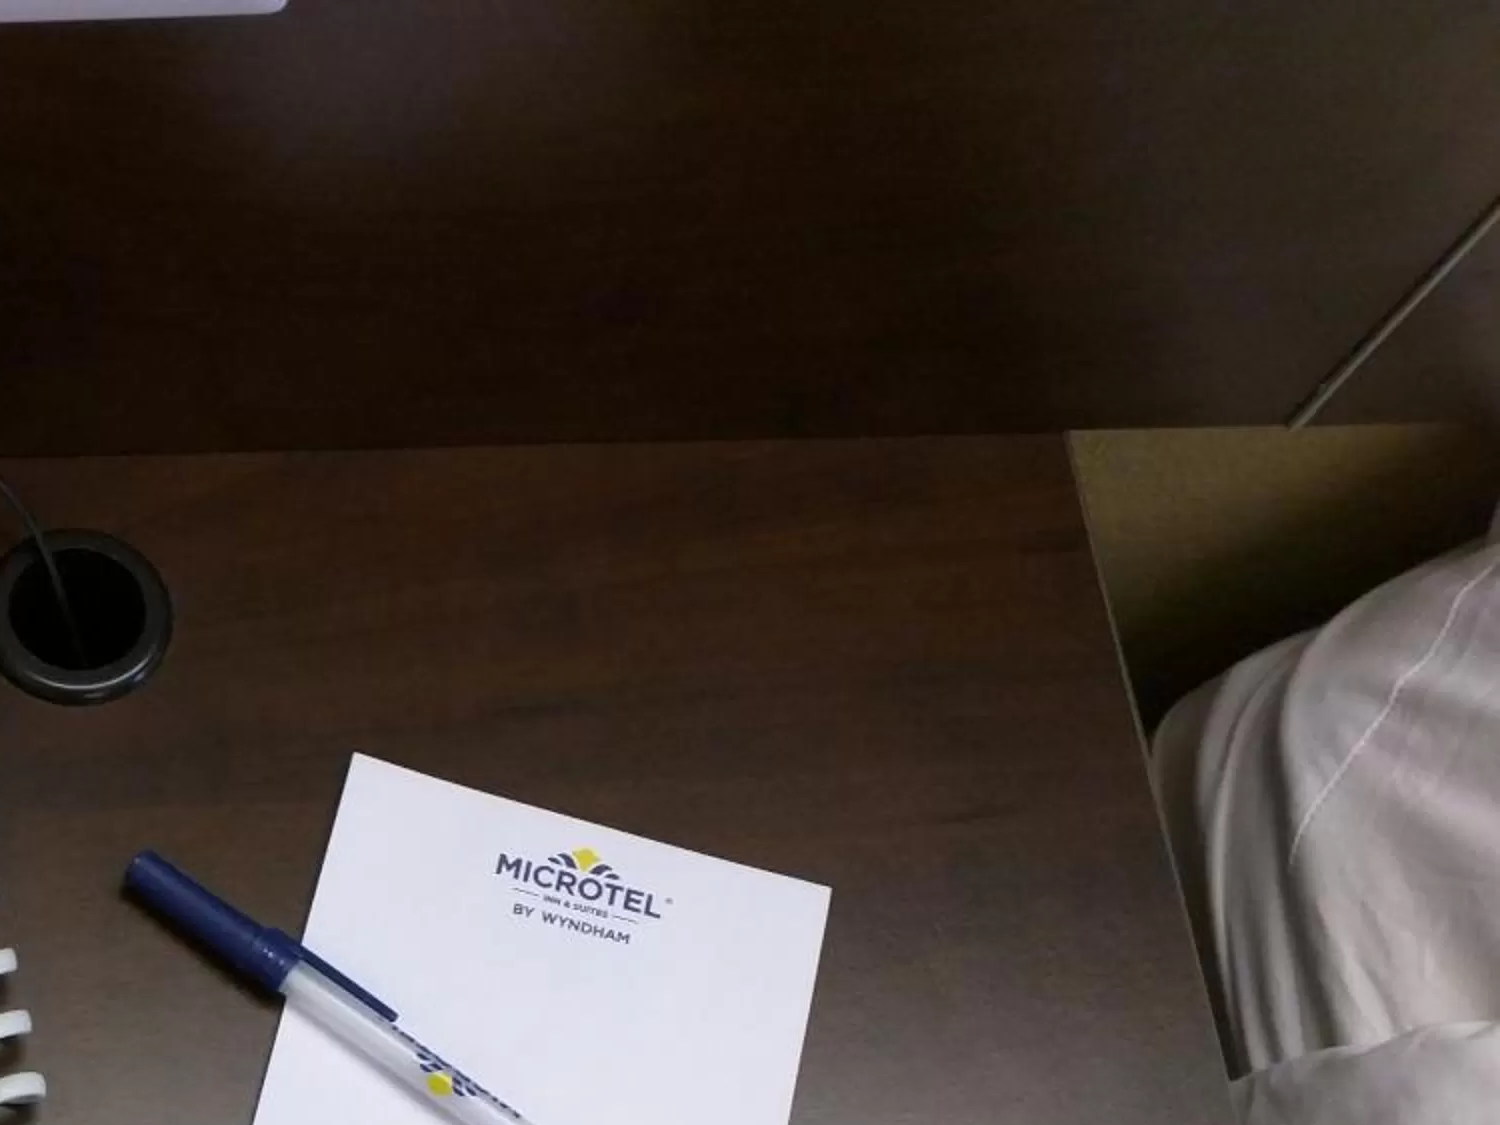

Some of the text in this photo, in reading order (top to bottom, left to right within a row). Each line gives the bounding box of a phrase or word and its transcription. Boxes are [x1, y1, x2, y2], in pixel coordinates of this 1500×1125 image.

[495, 853, 661, 919] MICROTEL
[513, 903, 631, 945] BY WYNDHAM
